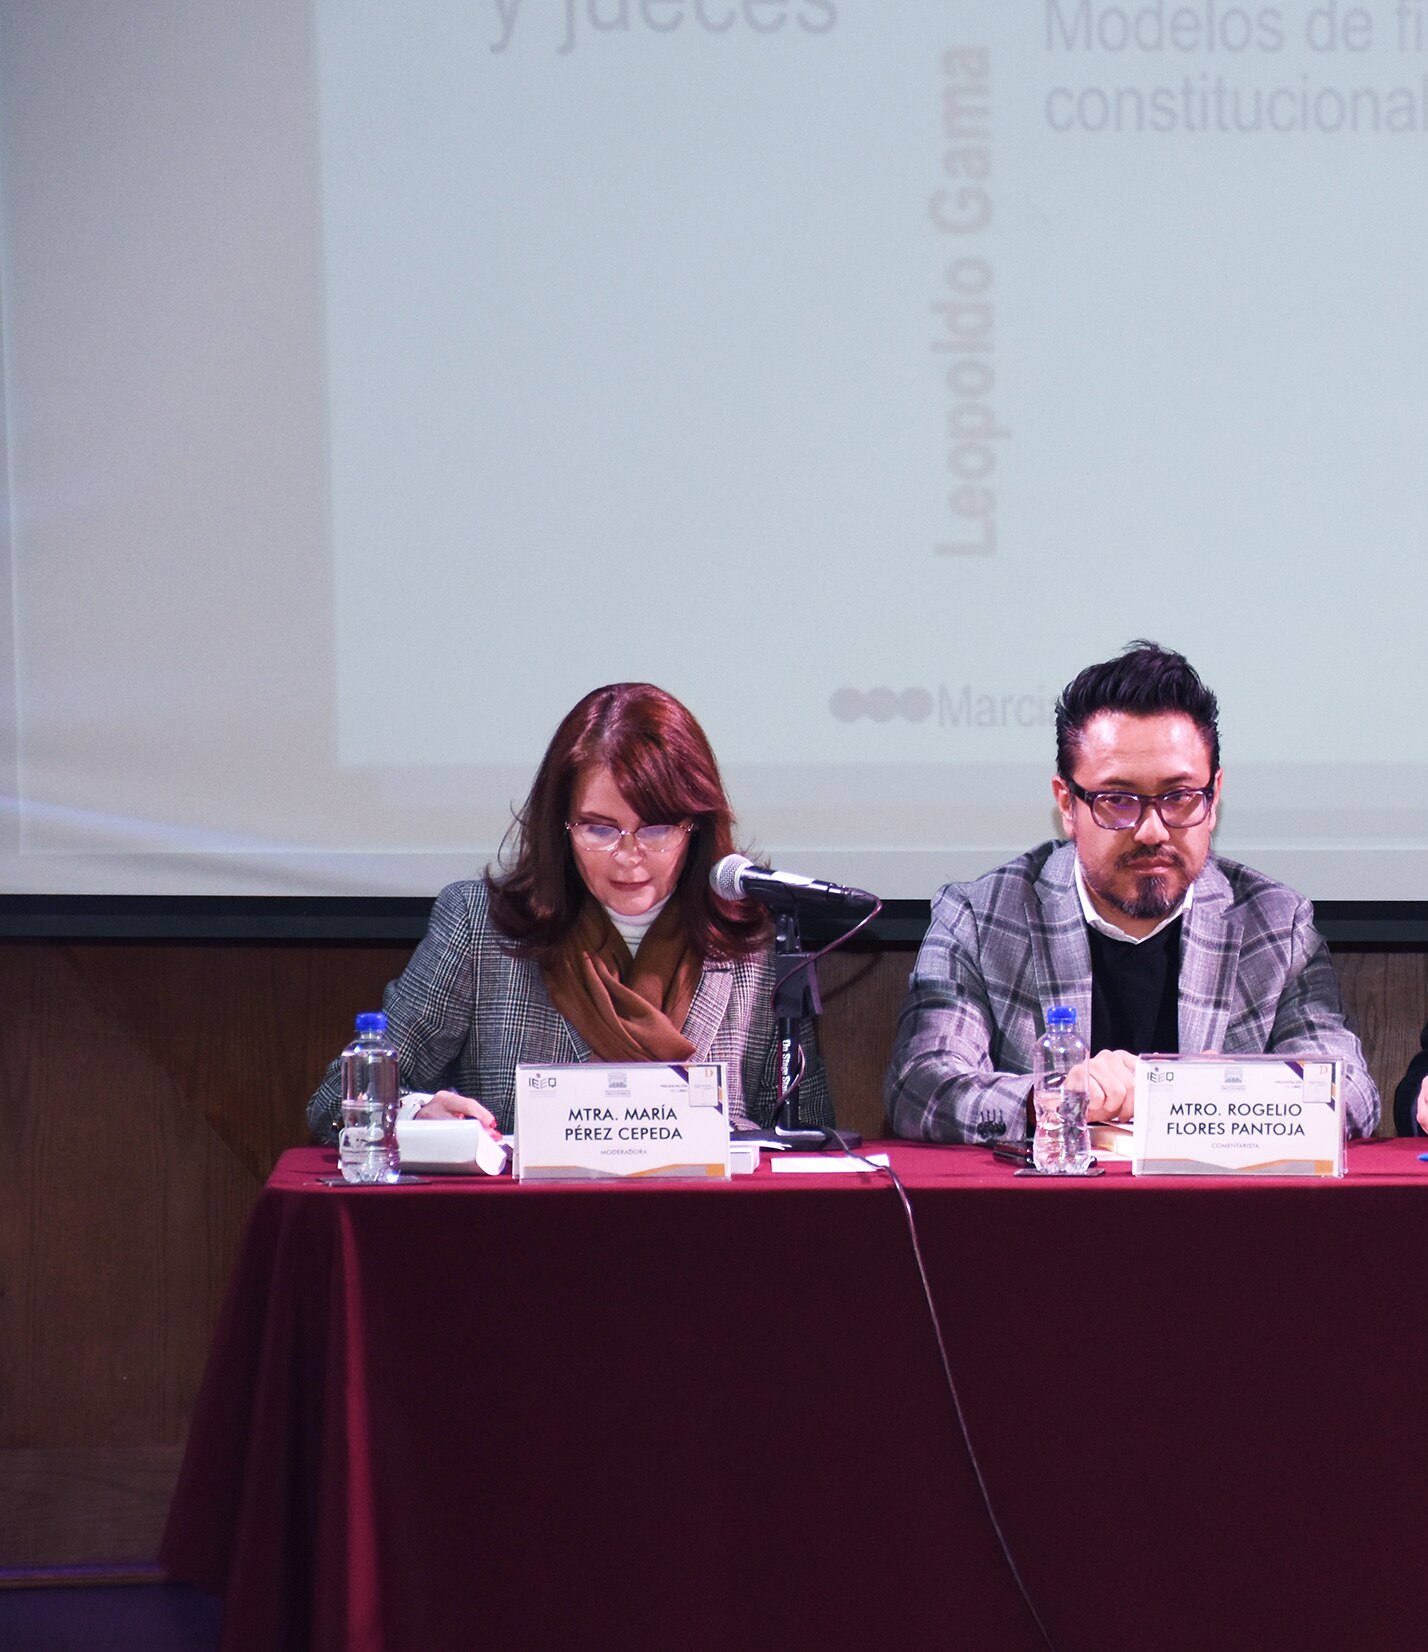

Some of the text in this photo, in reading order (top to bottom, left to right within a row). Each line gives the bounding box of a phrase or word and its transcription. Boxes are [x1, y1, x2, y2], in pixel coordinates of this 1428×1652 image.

[1043, 0, 1286, 53] Modelos
[1303, 0, 1375, 53] de
[927, 46, 1013, 557] Leopoldo Gama
[937, 683, 1055, 728] Marci
[568, 1104, 677, 1121] MTRA. MARÍA
[1169, 1103, 1303, 1117] MTRO. ROGELIO
[565, 1125, 683, 1141] PÉREZ CEPEDA
[1167, 1122, 1305, 1136] FLORES PANTOJA
